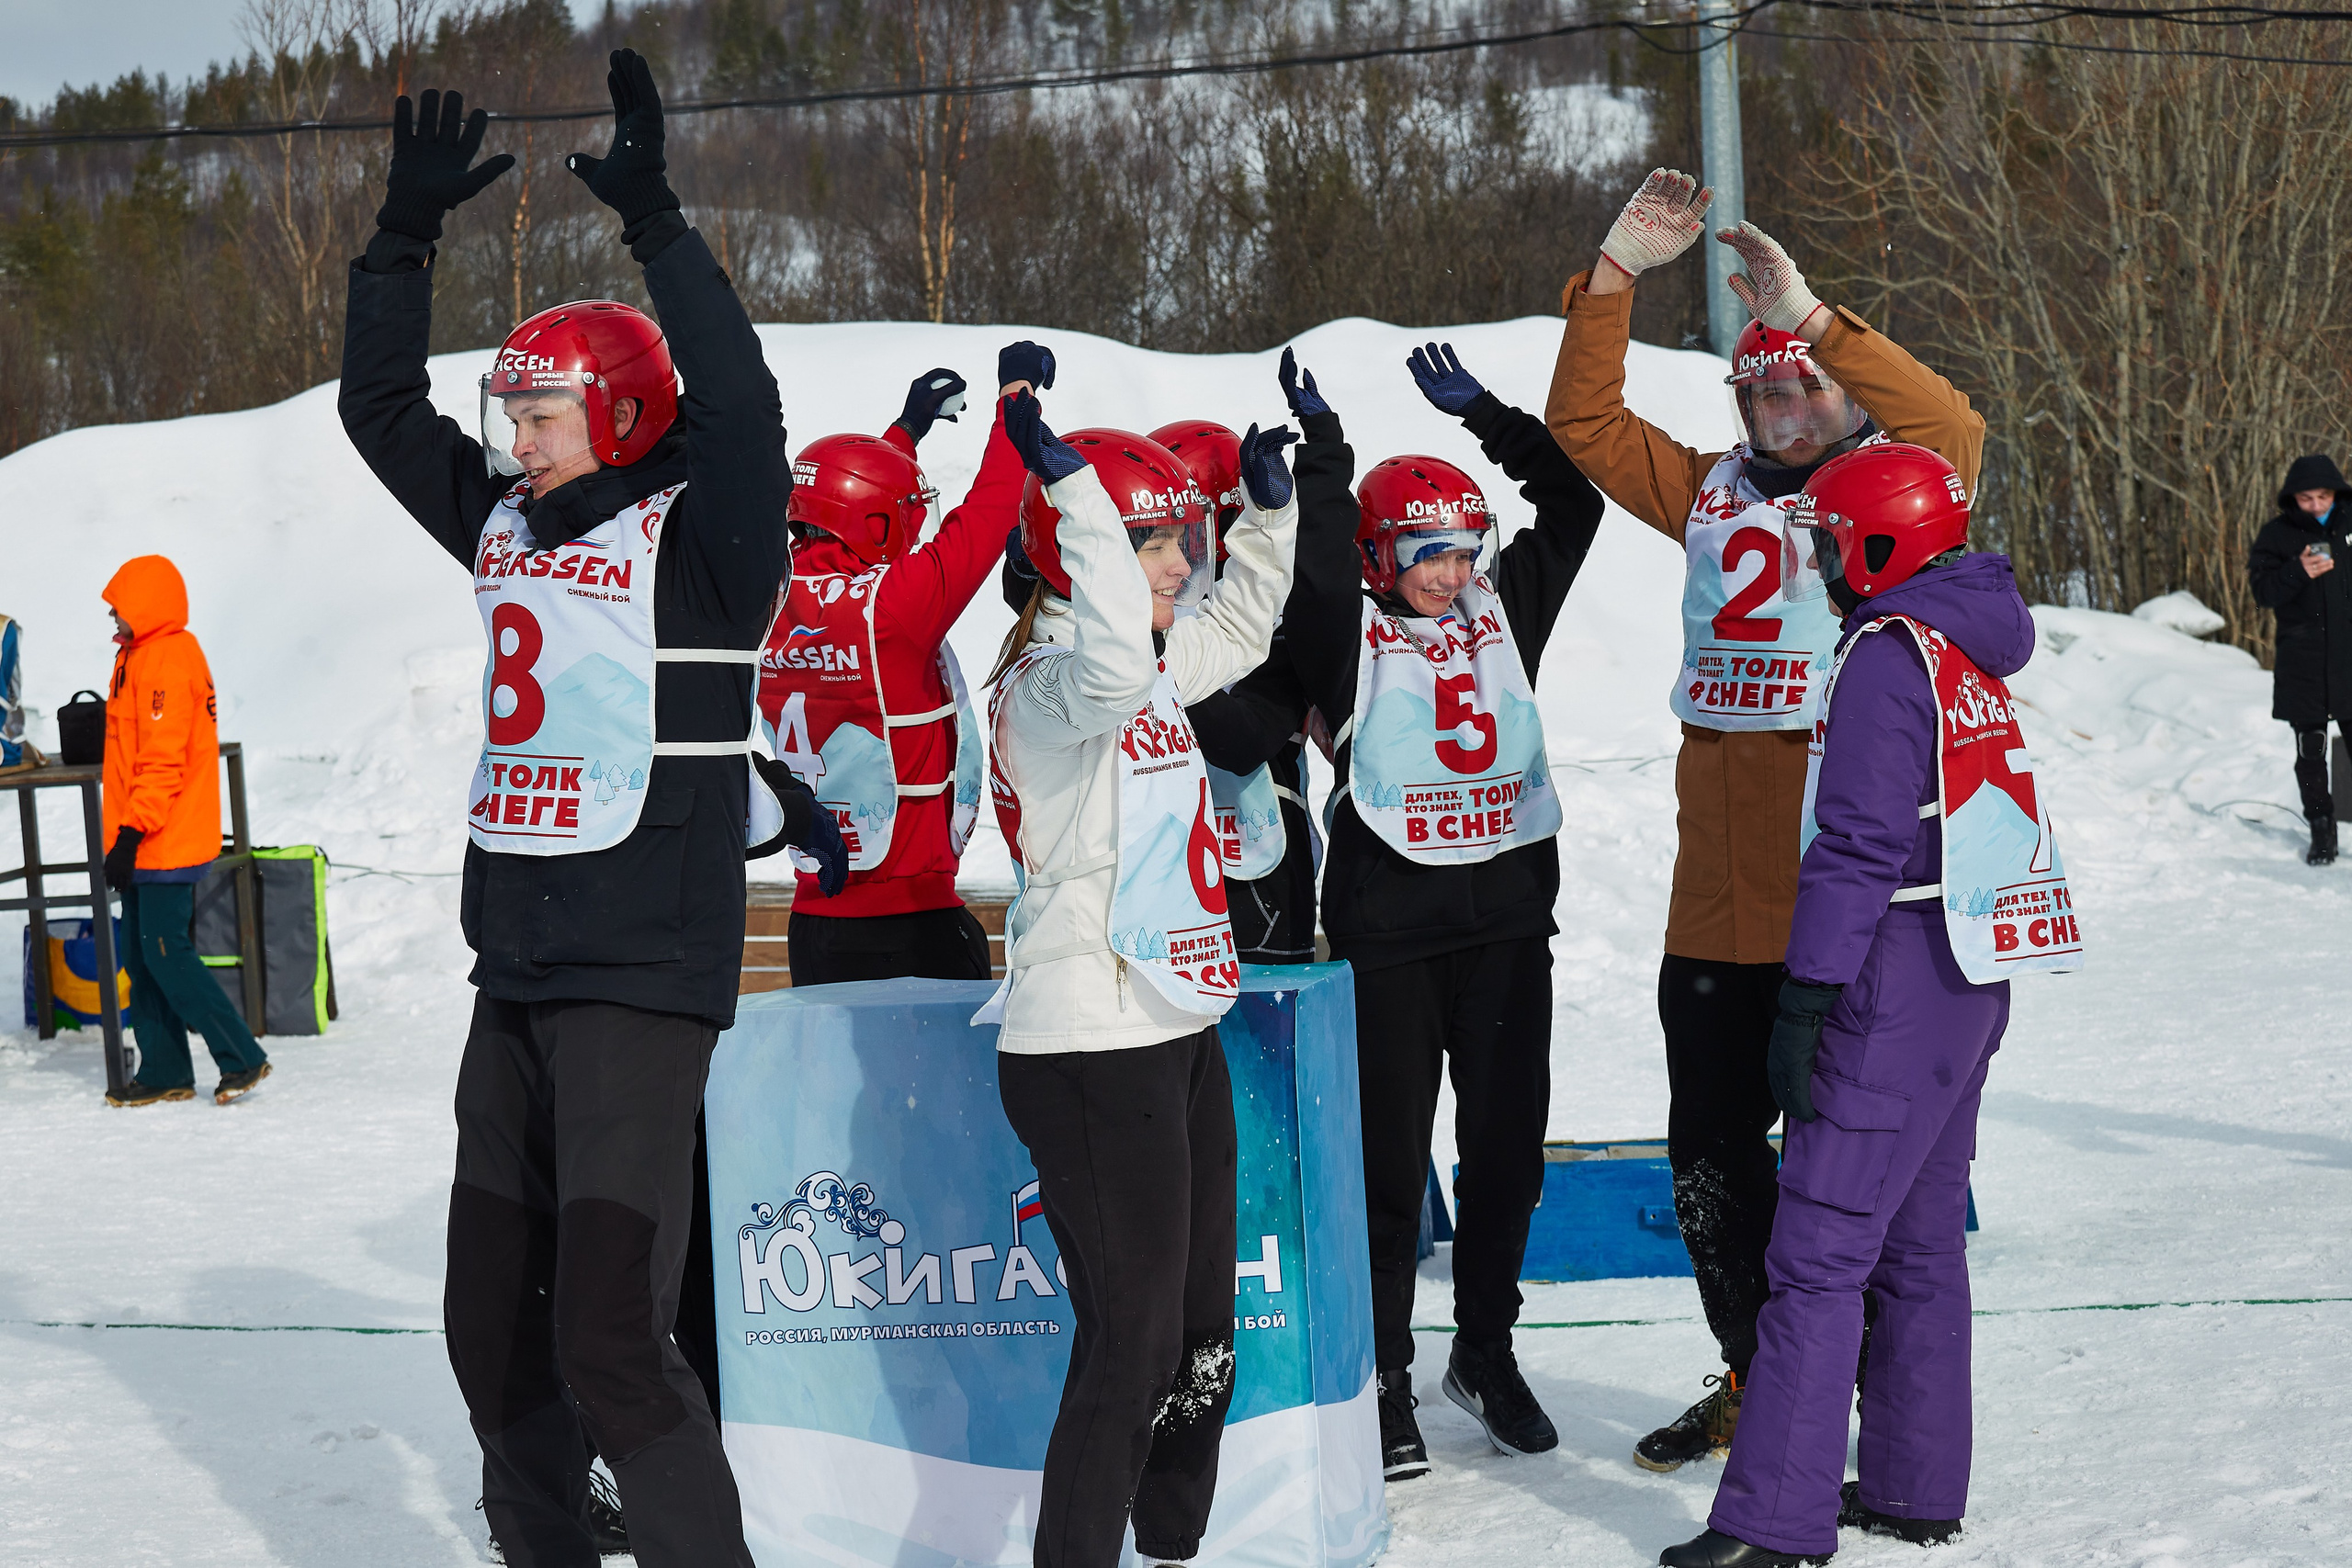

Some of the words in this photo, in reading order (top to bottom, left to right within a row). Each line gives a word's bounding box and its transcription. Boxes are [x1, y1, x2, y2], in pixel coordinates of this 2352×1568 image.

[496, 353, 554, 372] АССЕН
[796, 465, 818, 475] ТОЛК
[792, 474, 816, 486] НЕГЕ
[1131, 487, 1201, 511] ЮКИГА
[1122, 511, 1167, 522] МУРМАНСК
[1397, 517, 1433, 525] МУРМАНСК
[1711, 526, 1798, 641] 2
[567, 588, 609, 602] СНЕЖНЫЙ
[611, 594, 630, 604] БОЙ
[1710, 657, 1724, 667] ТЕХ,
[1730, 657, 1810, 680] ТОЛК
[1689, 681, 1705, 702] В
[1705, 681, 1807, 709] СНЕГЕ
[1435, 673, 1498, 774] 5
[775, 692, 826, 796] 4
[1953, 736, 1976, 748] RUSSIA,
[492, 763, 583, 791] ТОЛК
[1406, 792, 1432, 805] ДЛЯ
[1435, 791, 1463, 801] ТЕХ,
[485, 794, 580, 828] НЕГЕ
[1406, 805, 1428, 813] КТО
[1429, 803, 1464, 812] ЗНАЕТ
[1407, 818, 1430, 842] В
[1187, 777, 1227, 915] 6
[1994, 895, 2019, 909] ДЛЯ
[2020, 890, 2050, 903] ТЕХ,
[1993, 909, 2015, 919] КТО
[2016, 904, 2051, 917] ЗНАЕТ
[1170, 939, 1195, 955] ДЛЯ
[1196, 935, 1219, 949] ТЕХ,
[1993, 923, 2019, 953] В
[1170, 955, 1192, 966] КТО
[1192, 949, 1220, 963] ЗНАЕТ
[746, 1327, 829, 1345] РОССИЯ,
[831, 1323, 968, 1341] МУРМАНСКАЯ
[971, 1320, 1061, 1337] ОБЛАСТЬ
[1243, 1309, 1287, 1331] БОЙ
